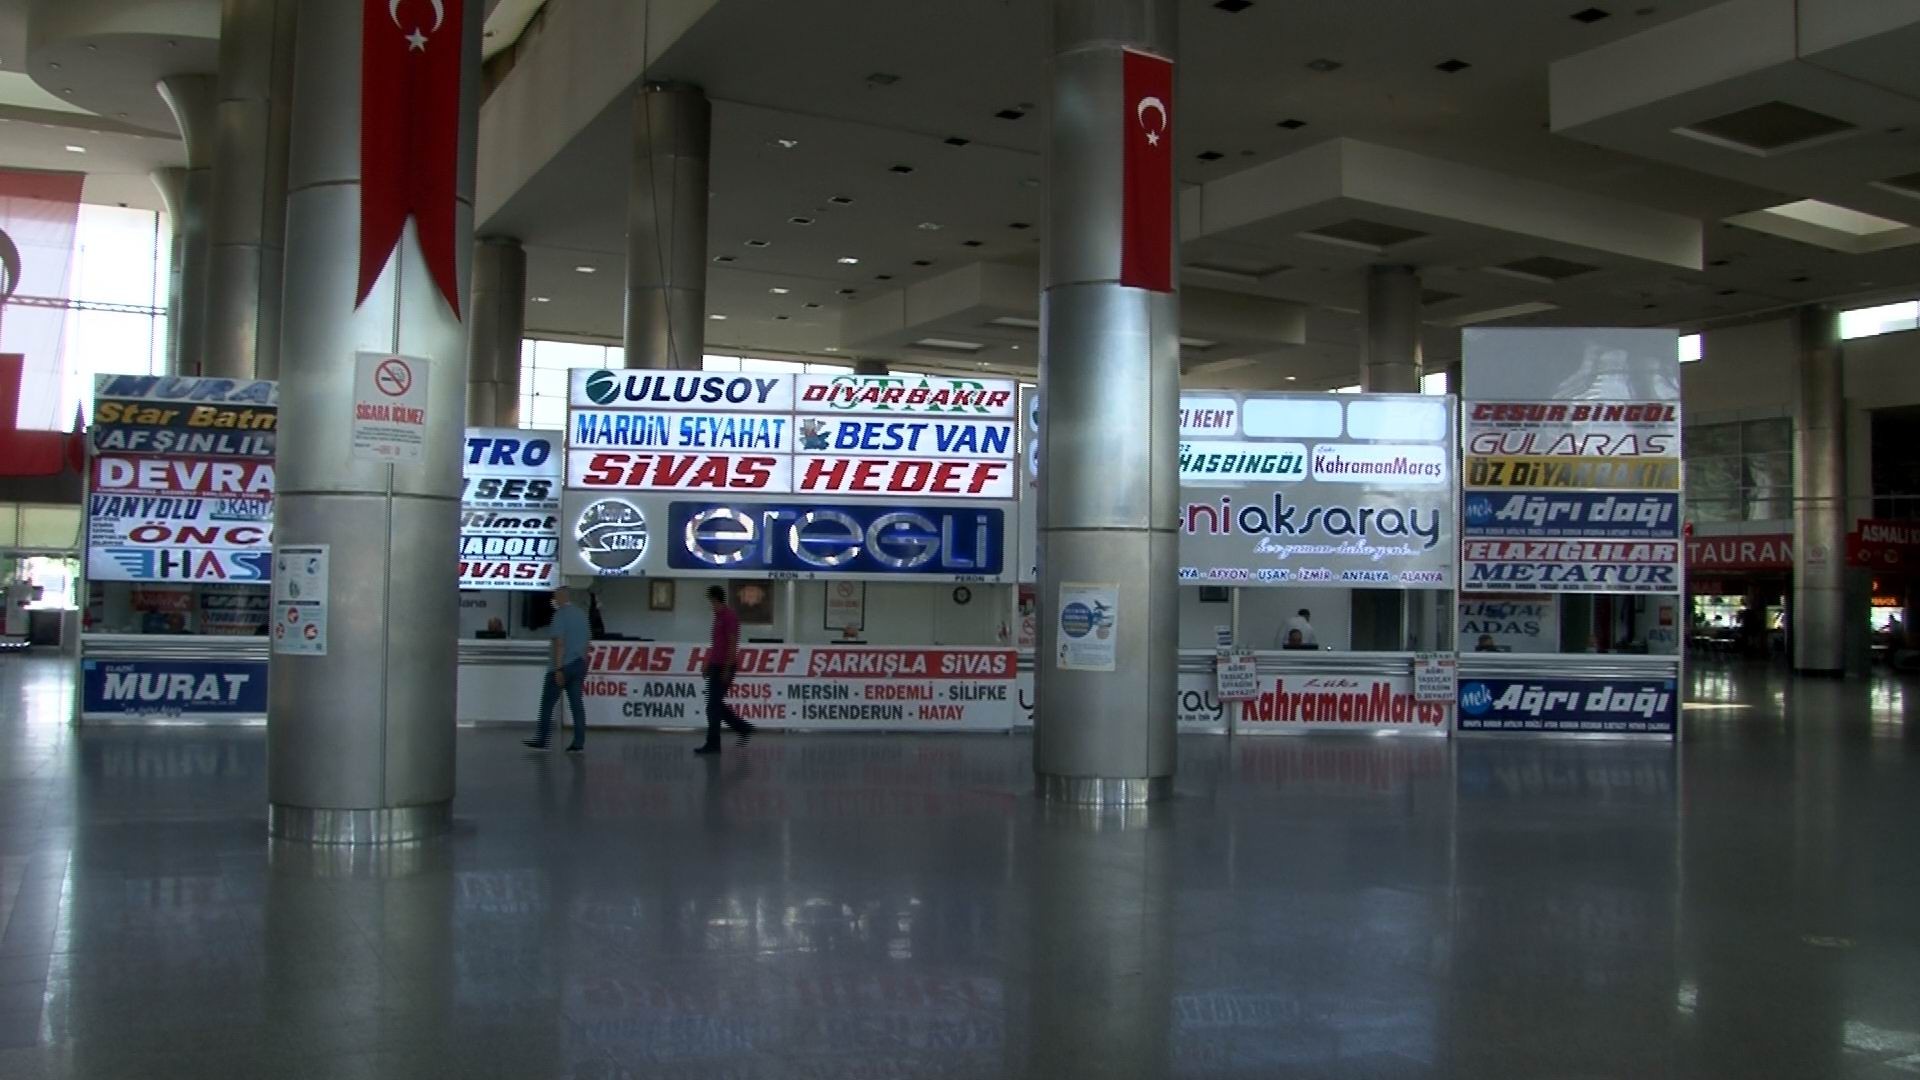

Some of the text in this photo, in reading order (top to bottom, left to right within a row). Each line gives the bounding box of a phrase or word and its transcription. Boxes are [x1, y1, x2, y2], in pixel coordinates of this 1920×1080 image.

[624, 376, 779, 403] ULUSOY
[1192, 409, 1234, 428] KENT
[679, 416, 785, 448] SEYAHAT
[834, 422, 1010, 453] BEST VAN
[464, 438, 551, 467] TRO
[800, 459, 1007, 494] HEDEF
[474, 479, 552, 500] SES
[92, 496, 200, 519] VANYOLU
[129, 521, 274, 544] ÖNC
[1239, 493, 1440, 549] aksaray
[1209, 569, 1248, 580] AFYON
[1342, 572, 1389, 582] ANTALYA
[1401, 572, 1443, 582] ALANYA
[1470, 563, 1674, 584] METATUR
[687, 647, 799, 673] HDEF
[813, 653, 926, 677] ŞARKIŞLA
[103, 673, 249, 701] MURAT
[643, 683, 696, 698] ADANA
[788, 683, 849, 700] MERSİN
[864, 682, 933, 700] ERDEMLİ
[949, 682, 1006, 701] SİLİFKE
[622, 702, 685, 718] CEYHAN
[802, 701, 903, 720] İSKENDERUN
[918, 705, 965, 720] HATAY
